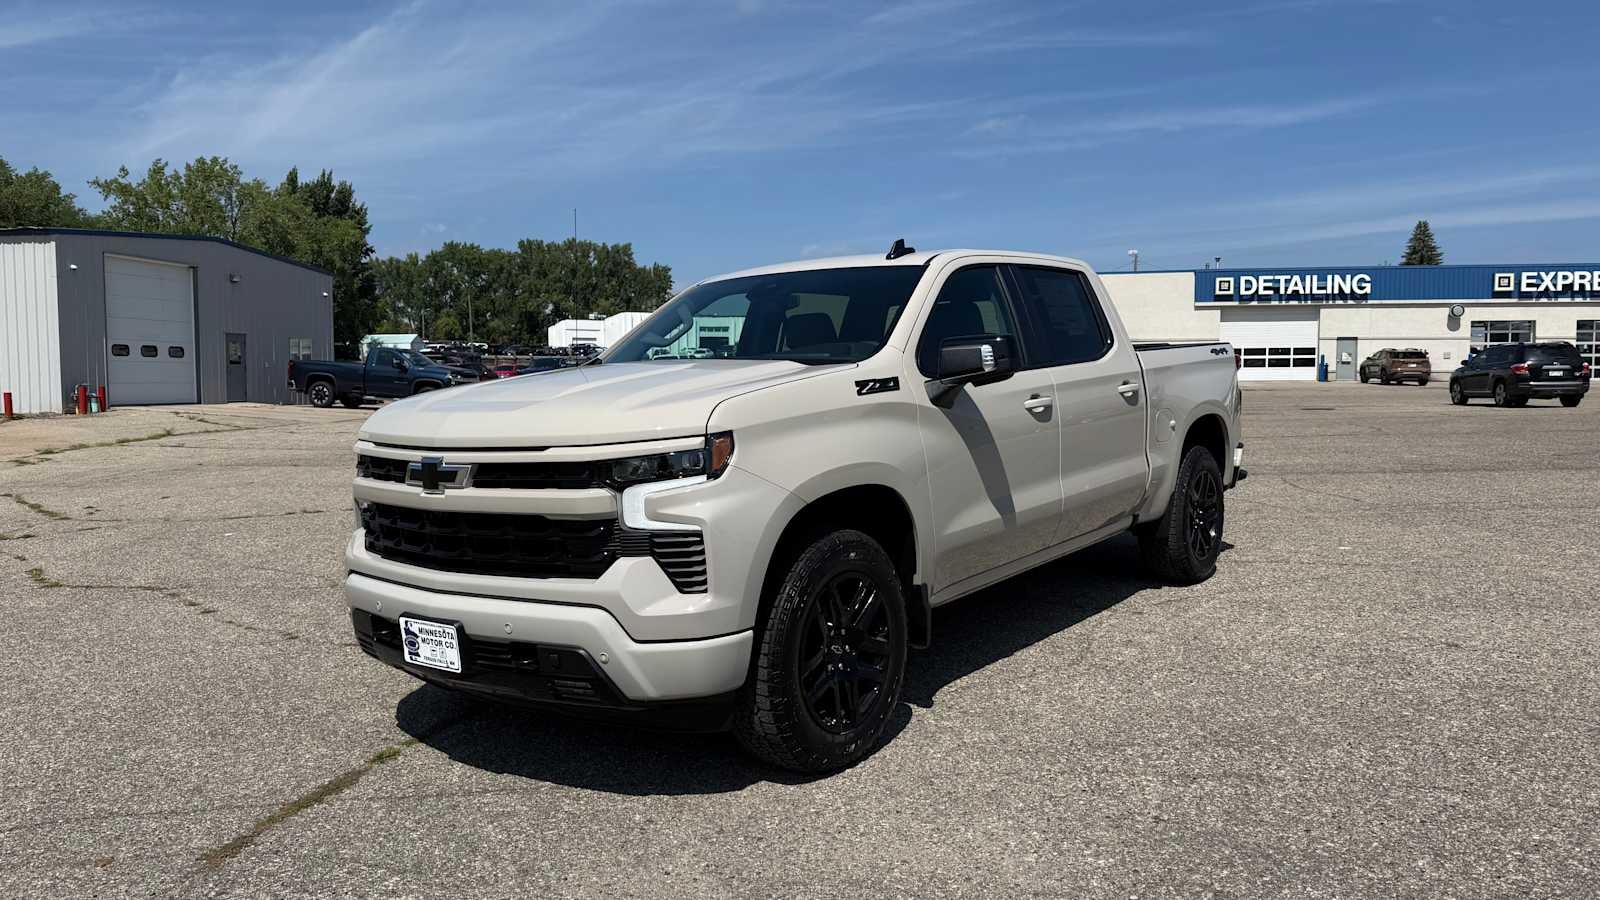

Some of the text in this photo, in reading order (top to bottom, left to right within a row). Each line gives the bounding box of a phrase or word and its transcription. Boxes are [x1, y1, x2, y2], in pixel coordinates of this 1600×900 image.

[1239, 273, 1372, 295] DETAILING
[418, 626, 455, 640] MINNESOTA
[421, 637, 444, 648] MOTOR
